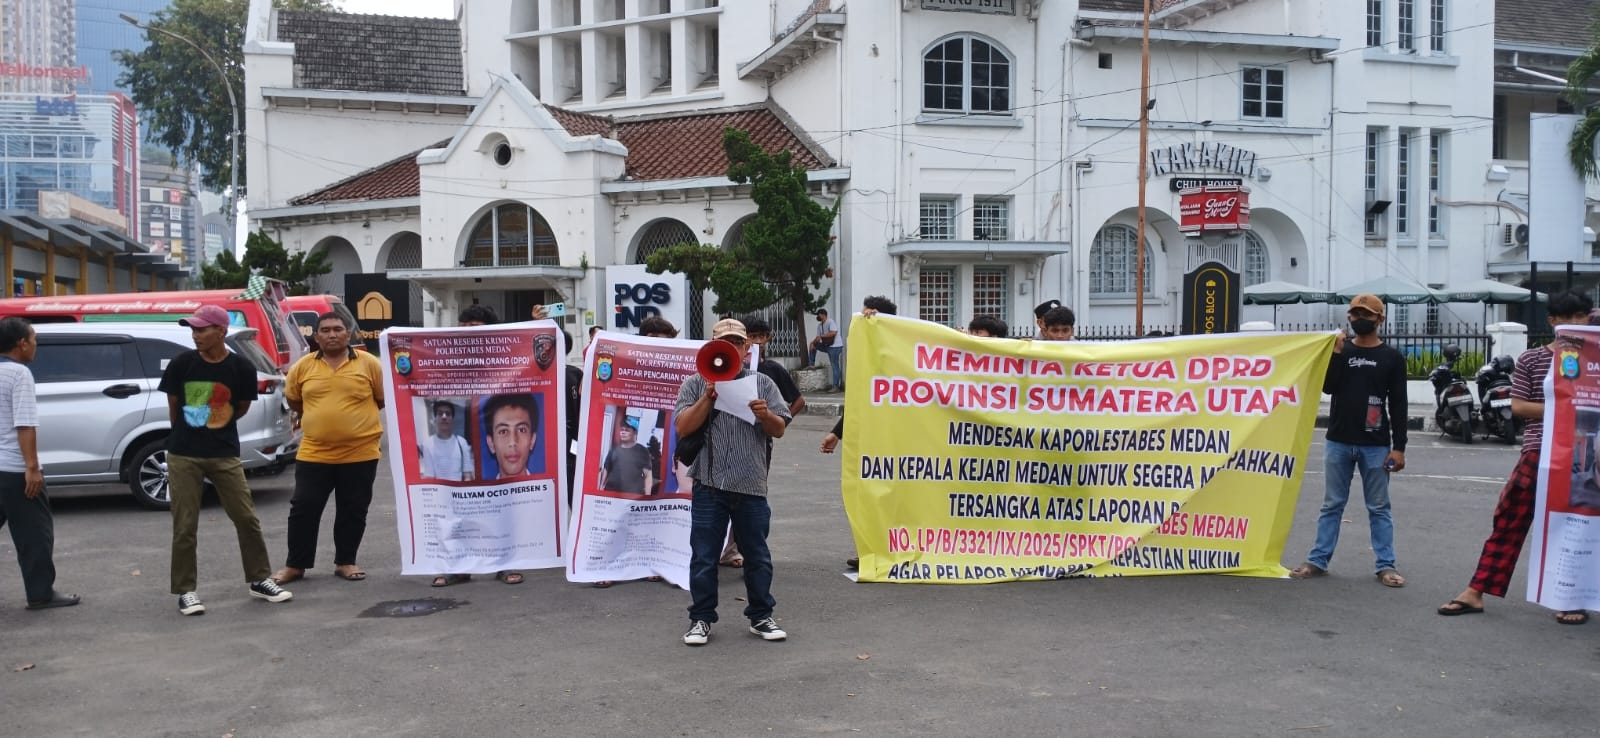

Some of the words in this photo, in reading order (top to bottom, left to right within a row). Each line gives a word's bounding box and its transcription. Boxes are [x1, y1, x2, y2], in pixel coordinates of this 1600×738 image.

[1151, 141, 1257, 179] KAKAKIKI
[615, 282, 671, 305] POS
[1205, 289, 1215, 314] BLOC
[423, 338, 452, 348] SATUAN
[453, 337, 485, 347] RESERSE
[485, 336, 522, 345] KRIMINAL
[435, 346, 484, 356] POLRESTABES
[485, 345, 512, 354] MEDAN
[627, 349, 653, 359] SATUAN
[418, 359, 444, 367] DAFTAR
[445, 357, 485, 367] PENCARIAN
[486, 357, 510, 366] ORANG
[511, 356, 530, 366] (DPO)
[917, 345, 1063, 376] MEMINTA
[1074, 360, 1176, 380] KETUA
[1188, 357, 1272, 381] DPRD
[618, 368, 643, 378] DAFTAR
[643, 370, 679, 382] PENCARIAN
[873, 379, 1017, 410] PROVINSI
[1028, 387, 1197, 413] SUMATERA
[948, 421, 1035, 449] MENDESAK
[1039, 428, 1166, 452] KAPORLESTABES
[1170, 428, 1231, 454] MEDAN
[861, 455, 895, 480] DAN
[899, 456, 954, 481] KEPALA
[958, 457, 1010, 483] KEJARI
[1015, 460, 1073, 486] MEDAN
[1077, 463, 1129, 486] UNTUK
[1133, 463, 1195, 489] SEGERA
[451, 491, 485, 499] WILLYAM
[486, 489, 509, 498] OCTO
[510, 484, 541, 495] PIERSEN
[630, 505, 658, 513] SATRYA
[949, 493, 1040, 520] TERSANGKA
[1045, 498, 1084, 521] ATAS
[1088, 499, 1165, 524] LAPORAN
[889, 528, 915, 552] NO.
[1192, 514, 1249, 540] MEDAN
[888, 561, 931, 579] AGAR
[936, 564, 1007, 580] PELAPOR
[1188, 549, 1241, 569] HUKUM
